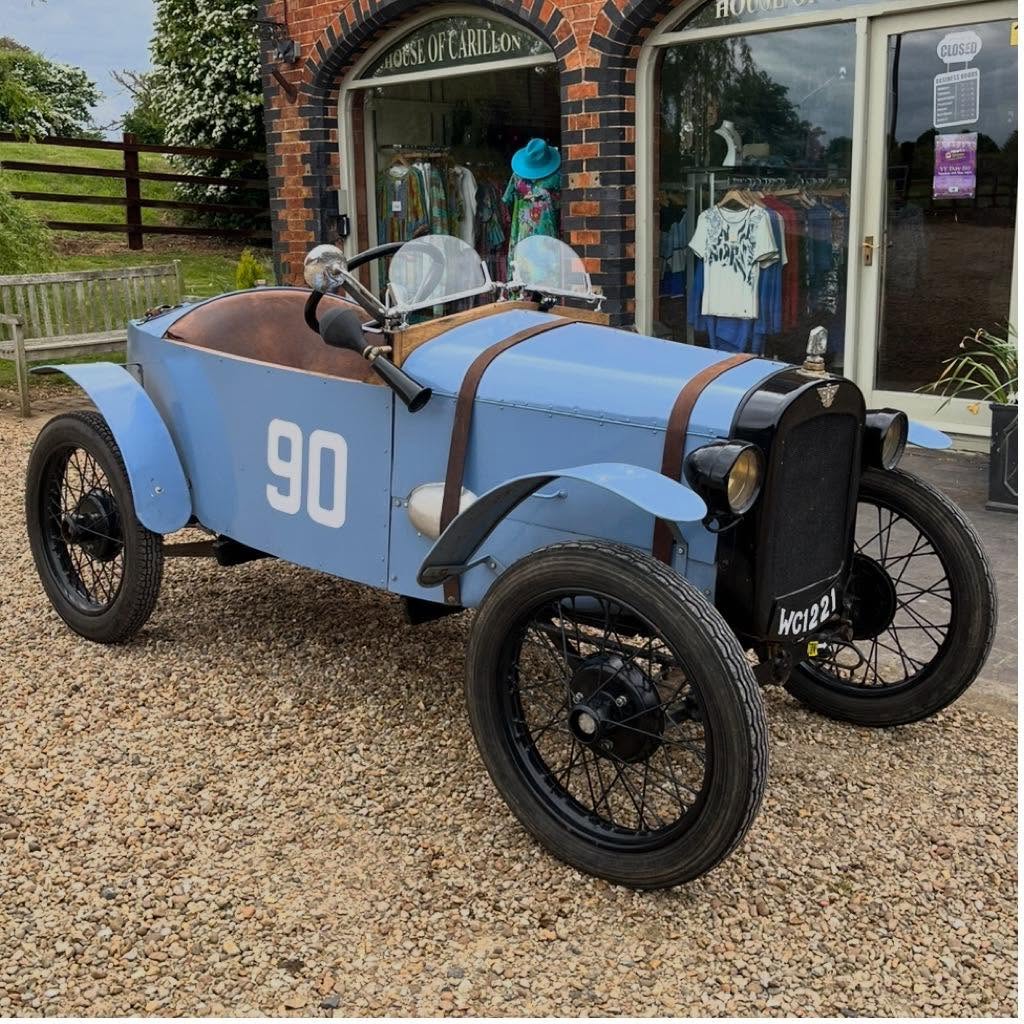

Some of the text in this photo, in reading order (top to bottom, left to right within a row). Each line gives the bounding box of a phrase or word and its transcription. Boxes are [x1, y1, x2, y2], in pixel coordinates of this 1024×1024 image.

[384, 28, 522, 69] HOUSE OF CARILLON
[940, 41, 978, 58] CLOSED
[266, 418, 348, 529] 90
[778, 587, 837, 636] WC1221
